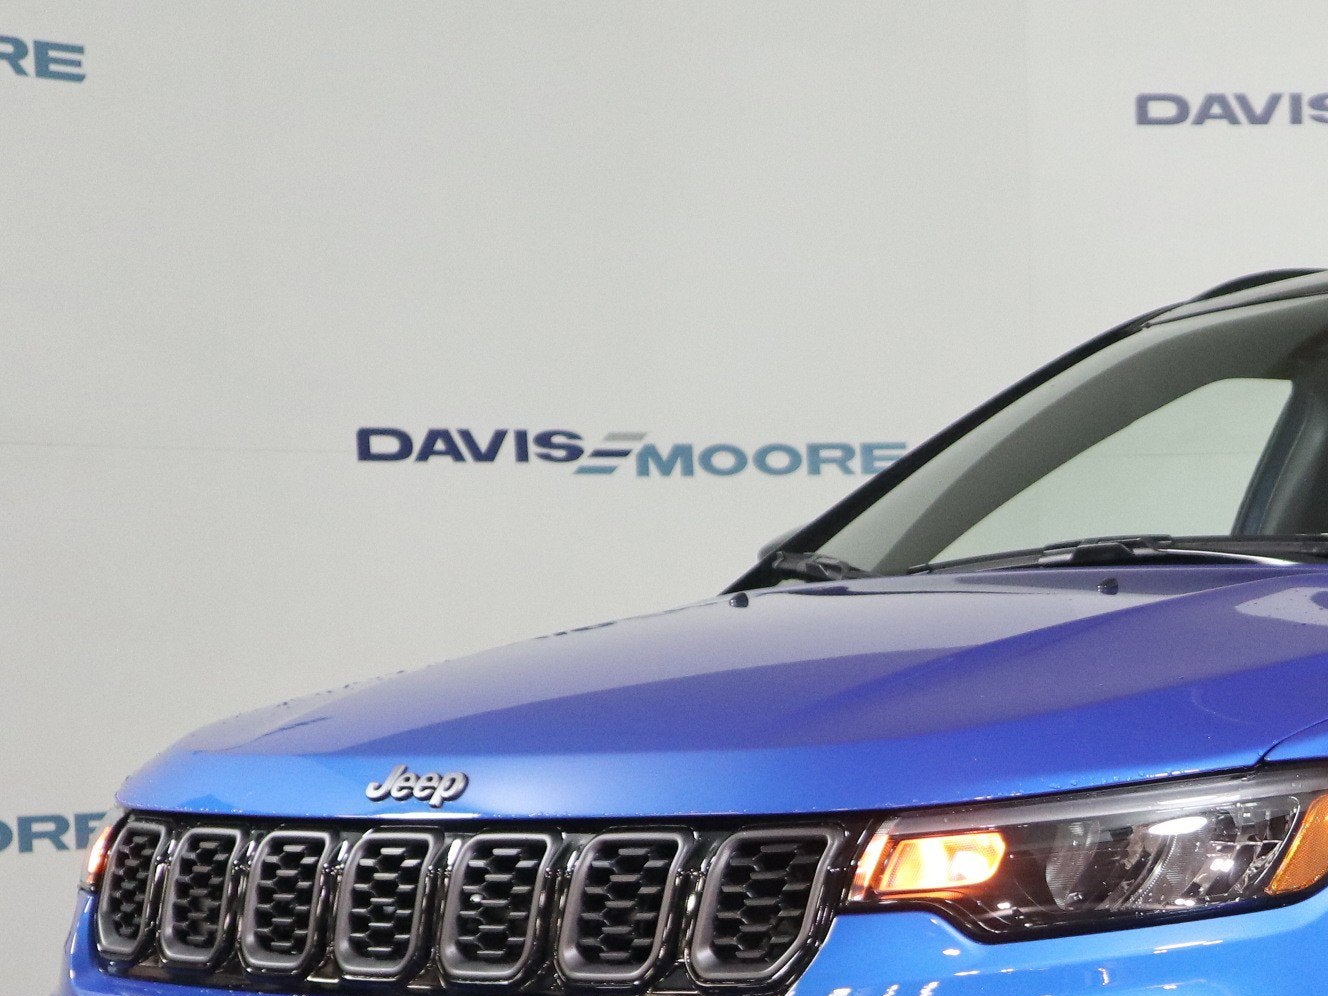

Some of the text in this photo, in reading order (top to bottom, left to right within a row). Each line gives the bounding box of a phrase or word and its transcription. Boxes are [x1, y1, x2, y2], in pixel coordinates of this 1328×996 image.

[356, 427, 907, 477] DAVIS MOORE
[365, 764, 470, 809] Jeep
